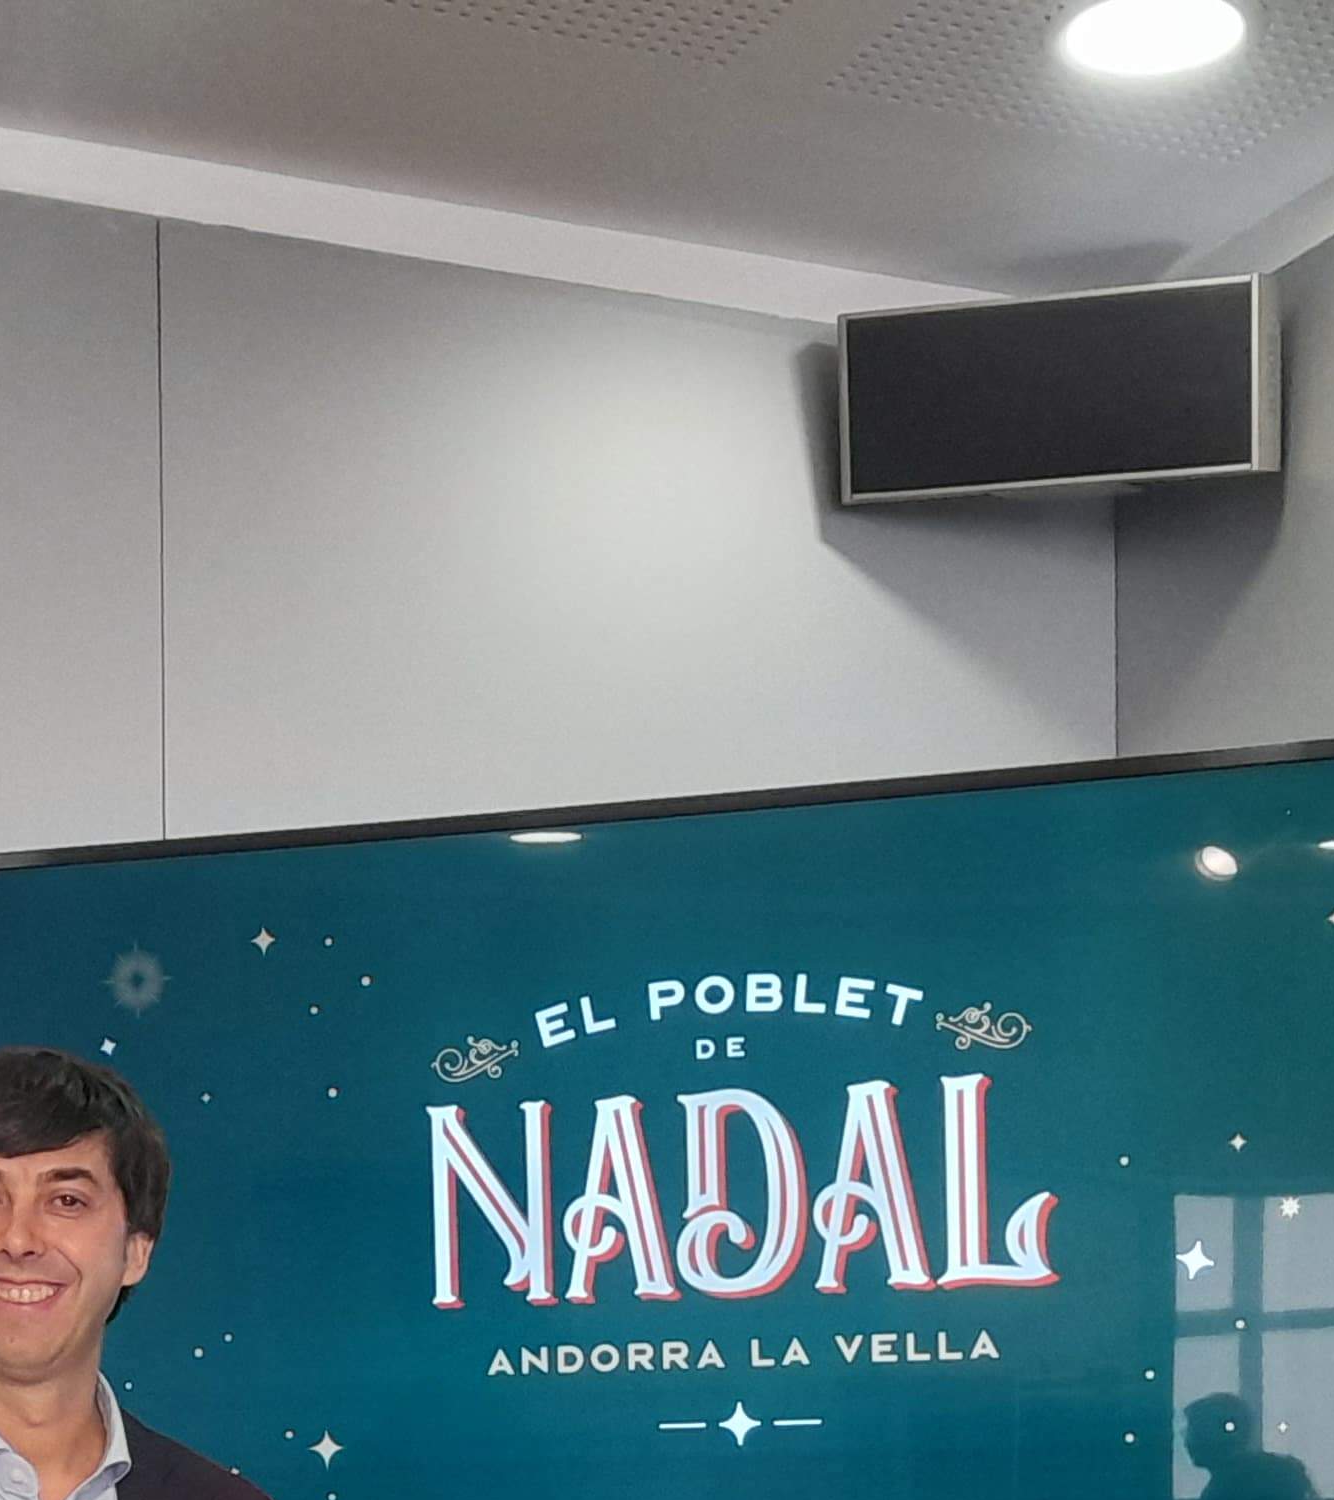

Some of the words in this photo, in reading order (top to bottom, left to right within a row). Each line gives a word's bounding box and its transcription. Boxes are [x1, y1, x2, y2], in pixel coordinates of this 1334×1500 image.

[535, 996, 616, 1048] EL
[648, 973, 924, 1026] POBLET
[696, 1036, 745, 1060] DE
[425, 1073, 1061, 1310] NADAL
[487, 1340, 725, 1376] ANDORRA
[751, 1337, 810, 1367] LA
[835, 1330, 1000, 1363] VELLA
